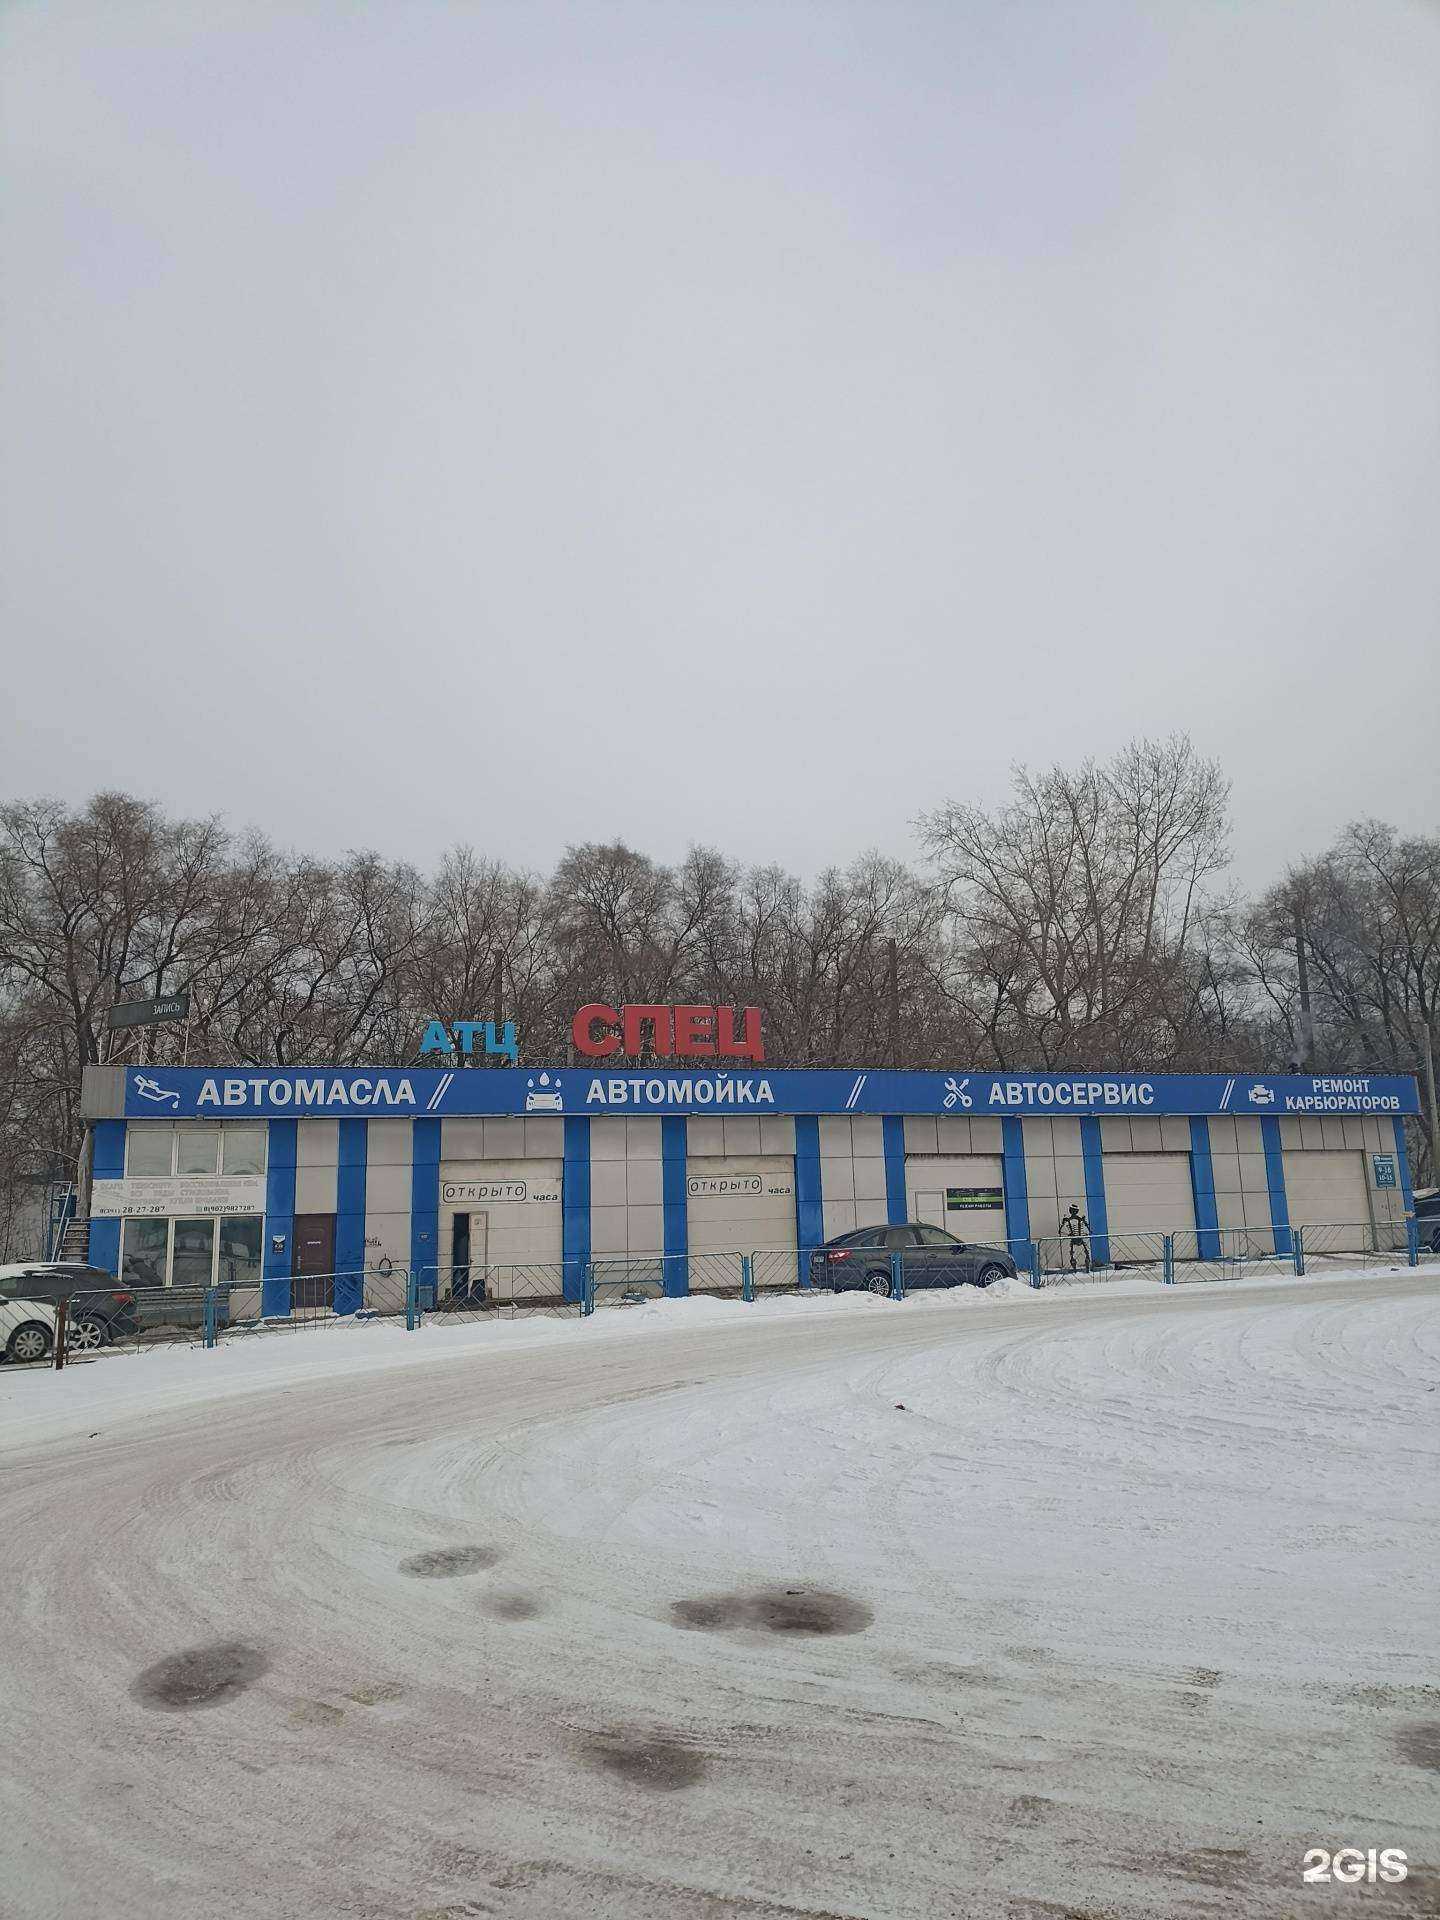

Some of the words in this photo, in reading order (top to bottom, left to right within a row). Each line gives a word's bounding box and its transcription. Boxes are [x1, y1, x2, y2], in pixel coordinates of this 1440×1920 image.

[152, 1002, 180, 1015] ЗАПИСЬ
[419, 1020, 519, 1062] АТЦ
[572, 1003, 765, 1062] СПЕЦ
[196, 1079, 416, 1107] АВТОМАСЛА
[586, 1073, 775, 1105] АВТОМОЙКА
[988, 1081, 1155, 1106] АВТОСЕРВИС
[1312, 1079, 1370, 1095] РЕМОНТ
[1285, 1095, 1400, 1111] КАРБЮРАТОРОВ
[532, 1193, 559, 1202] часа
[767, 1186, 791, 1195] часа
